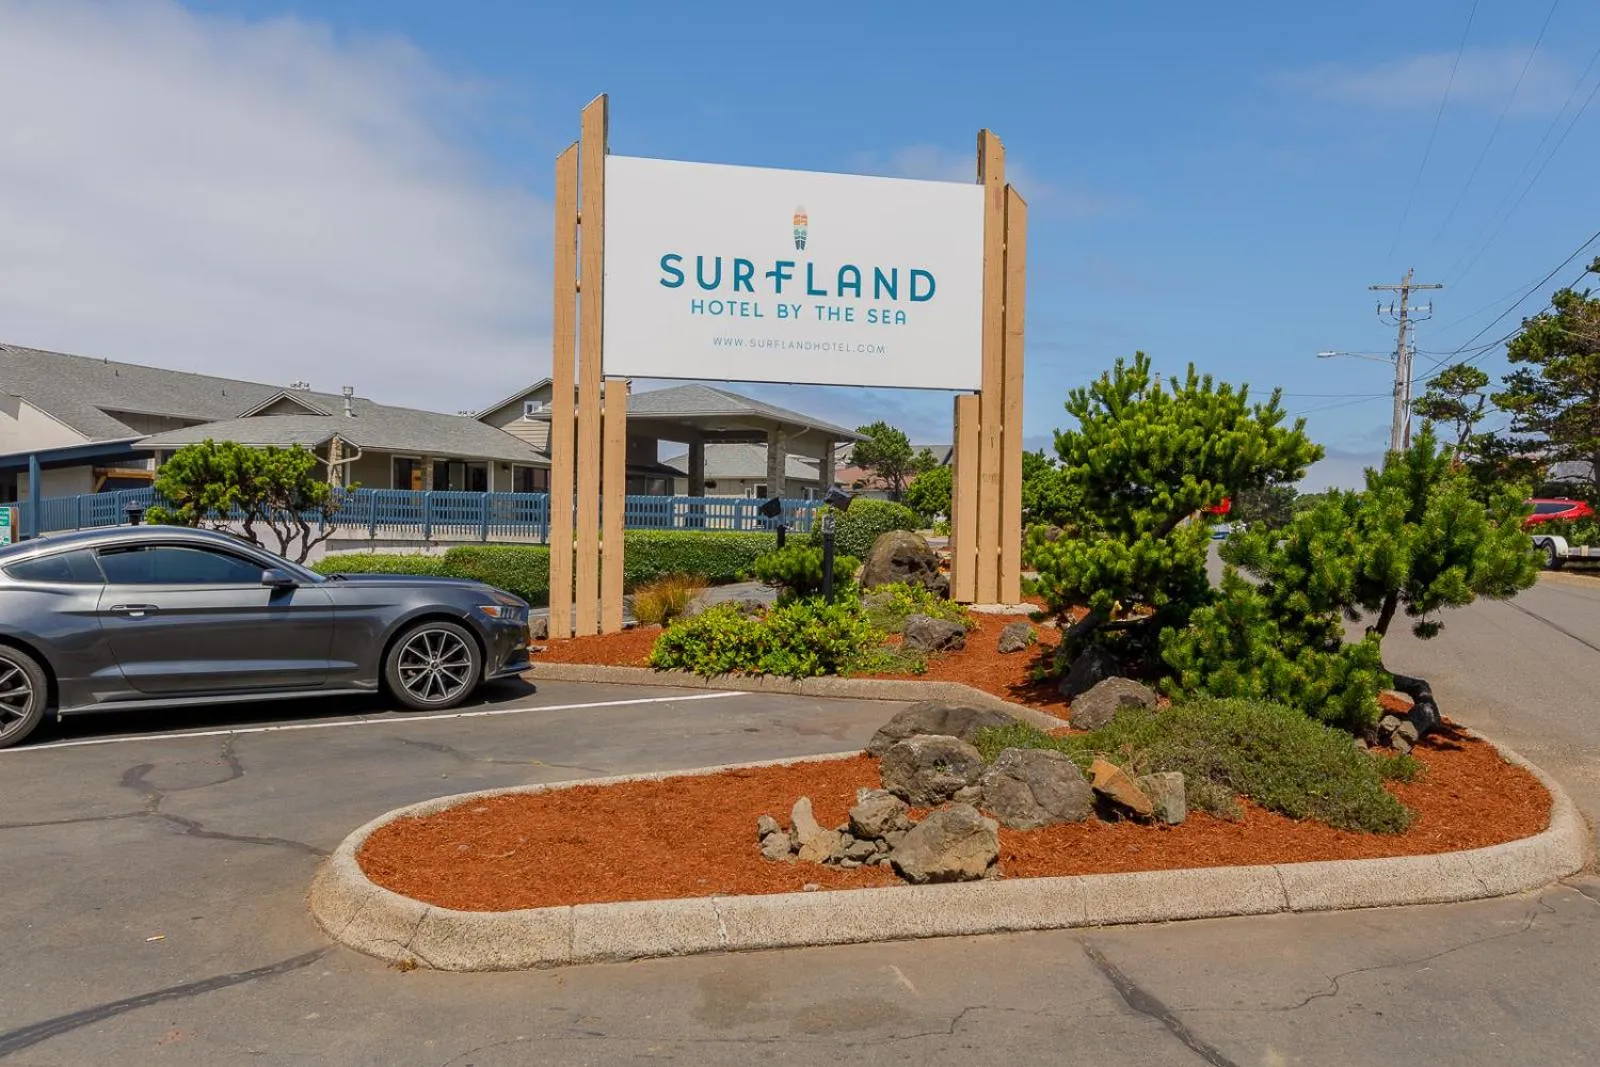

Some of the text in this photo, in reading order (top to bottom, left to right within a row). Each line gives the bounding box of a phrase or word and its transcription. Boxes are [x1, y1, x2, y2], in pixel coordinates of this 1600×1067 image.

[660, 253, 936, 303] SURFLAND
[691, 298, 907, 326] HOTEL BY THE SEA
[712, 337, 886, 354] WWW.SURFLANDHOTEL.COM
